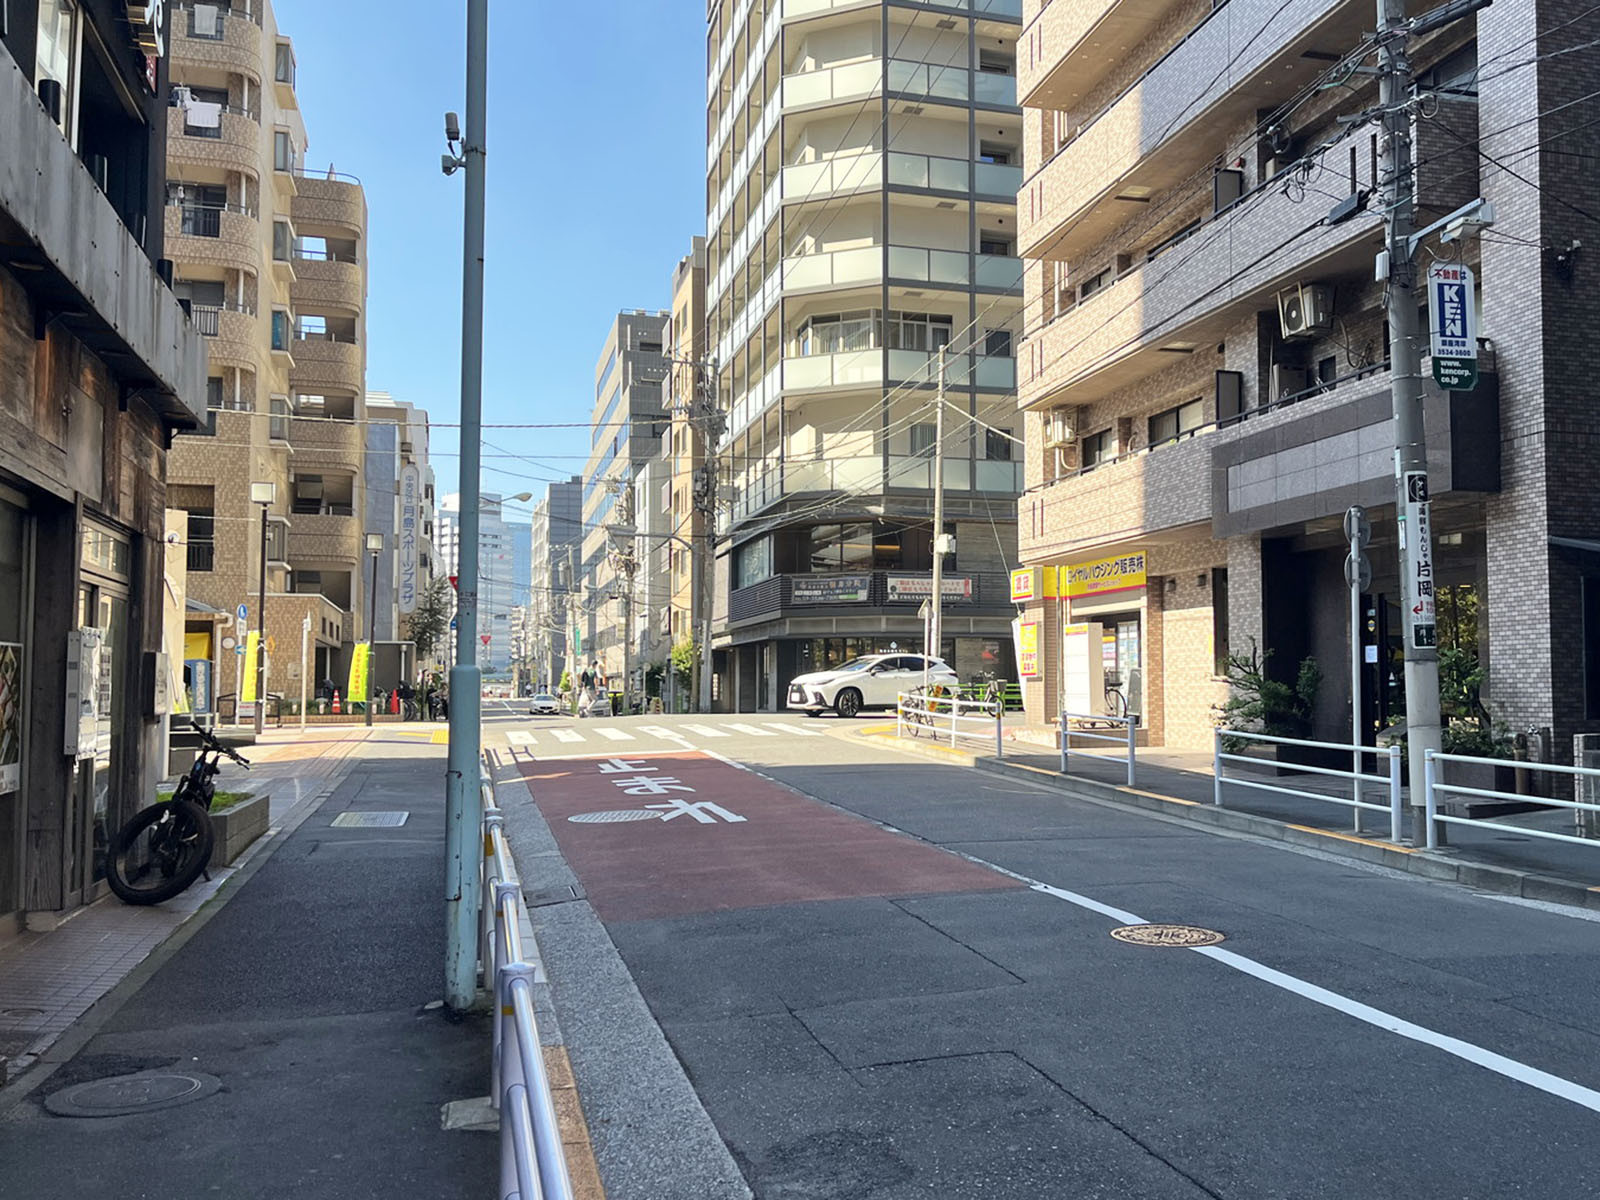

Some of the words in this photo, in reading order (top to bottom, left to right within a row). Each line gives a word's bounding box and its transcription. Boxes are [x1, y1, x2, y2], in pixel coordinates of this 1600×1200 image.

[1443, 285, 1462, 336] KEN
[1440, 367, 1472, 376] kencorp.
[1440, 376, 1459, 385] co.jp
[598, 758, 748, 824] 止まれ
